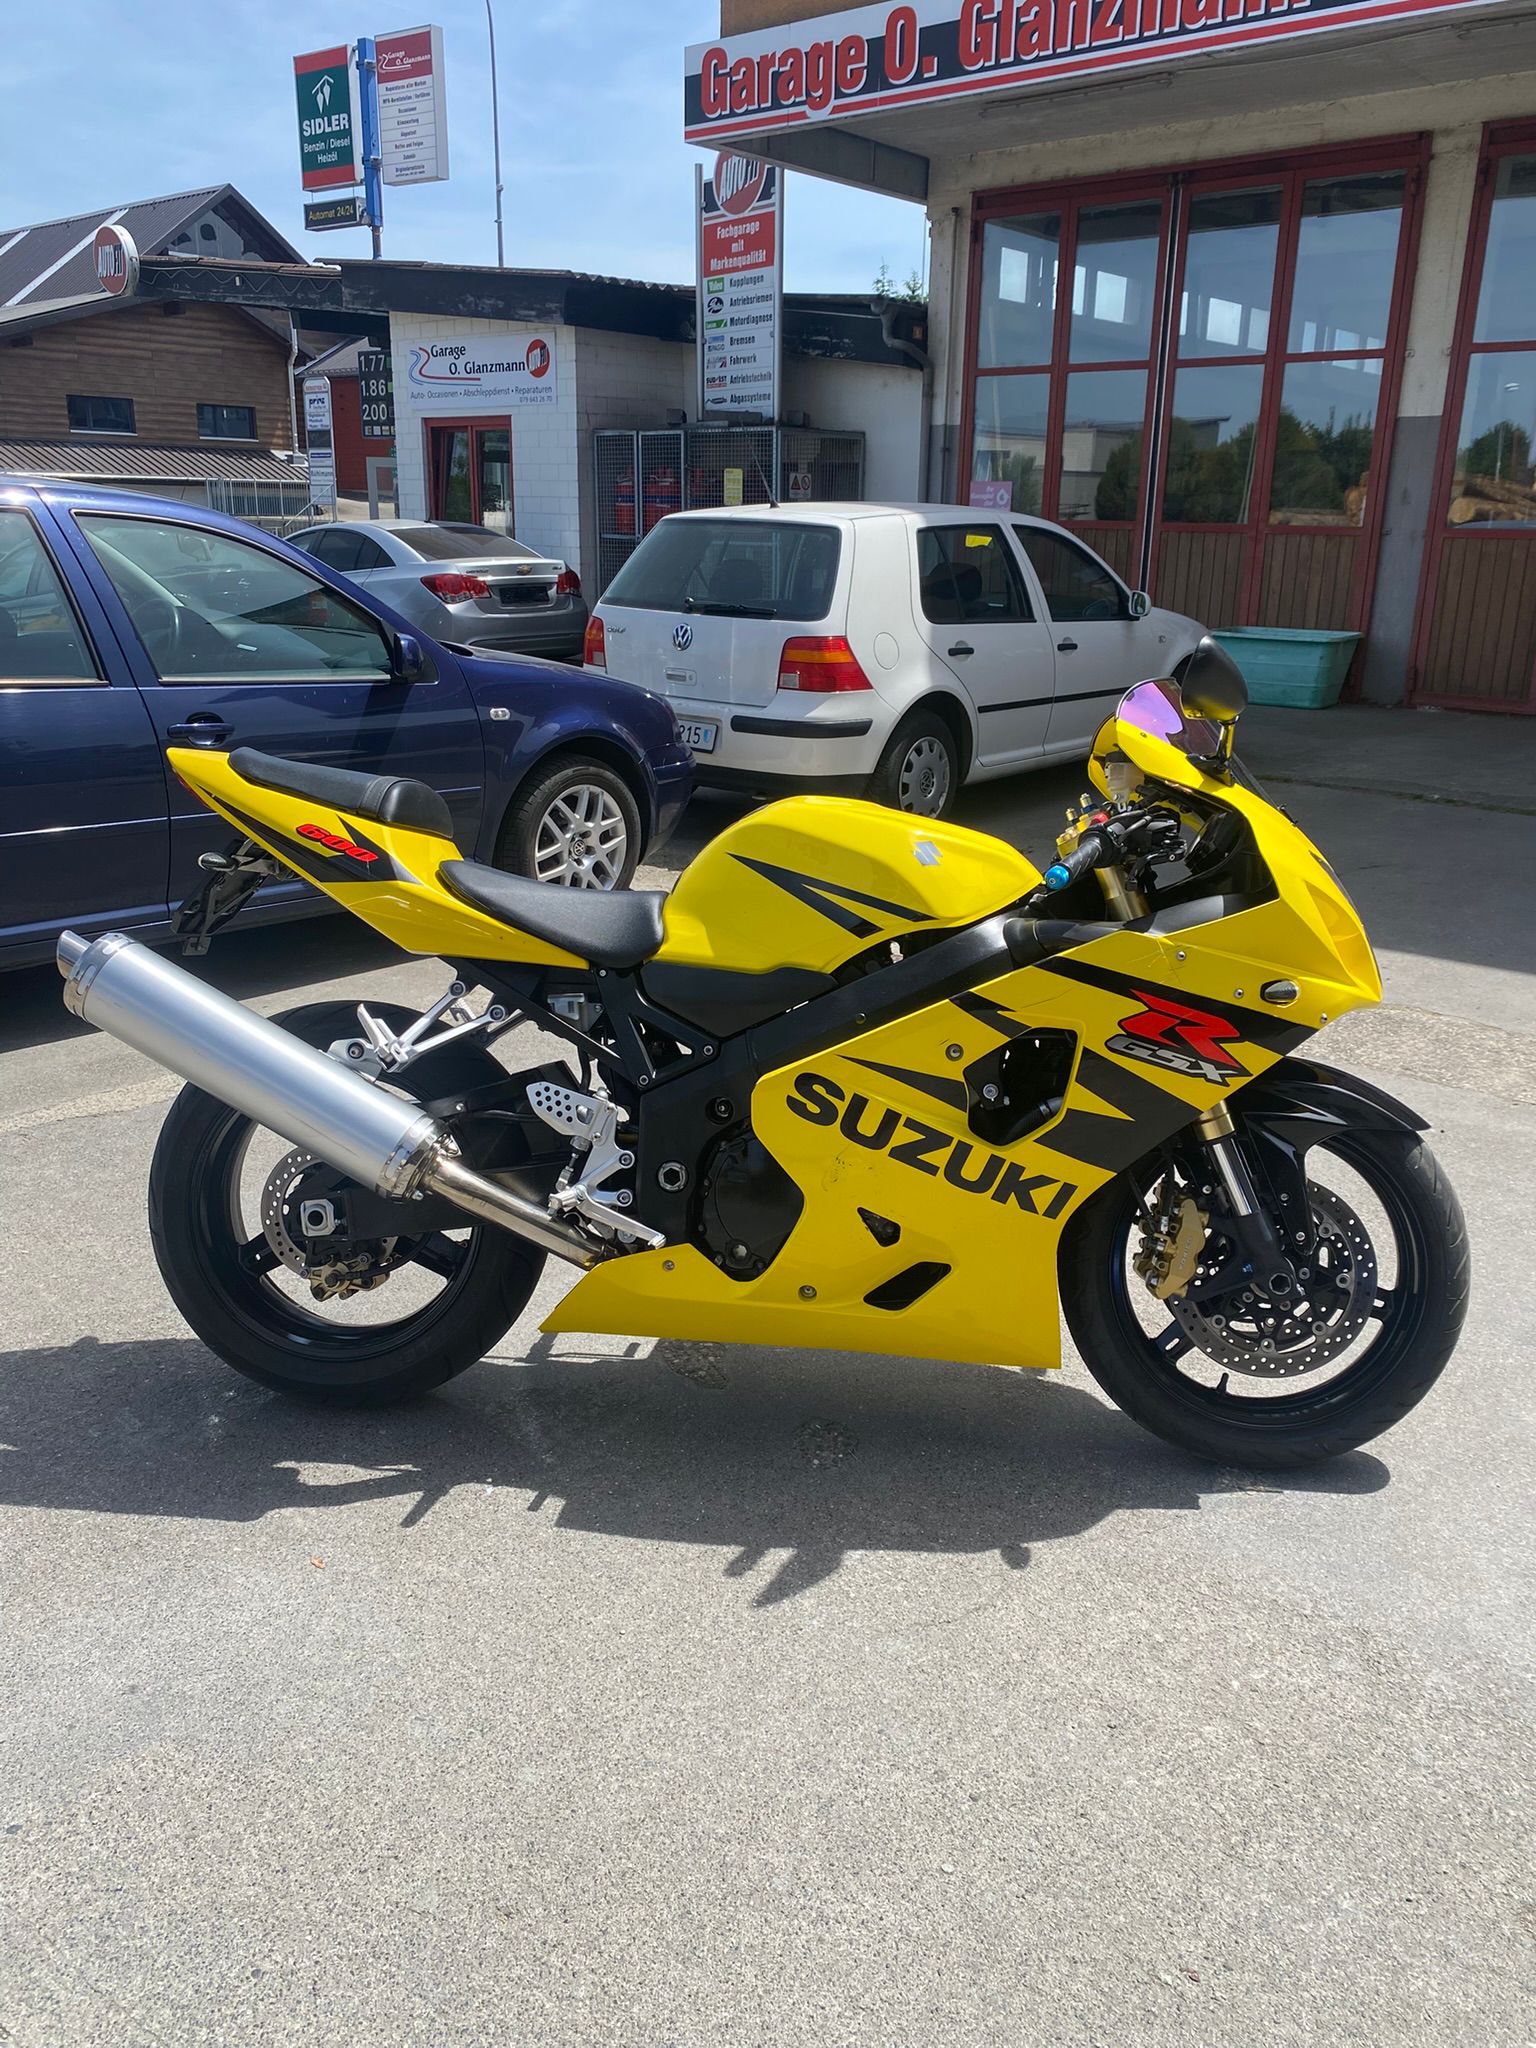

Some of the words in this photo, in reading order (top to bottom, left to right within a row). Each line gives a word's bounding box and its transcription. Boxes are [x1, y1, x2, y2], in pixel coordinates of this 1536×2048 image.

[387, 50, 405, 60] Garage
[402, 54, 431, 65] Glanzmann
[701, 35, 867, 118] Garage
[885, 5, 937, 84] O.
[302, 113, 349, 137] SIDLER
[303, 141, 326, 153] Benzin
[330, 136, 350, 149] Diesel
[317, 151, 338, 163] Heizöl
[309, 207, 335, 220] Automat
[336, 203, 354, 217] 24/24
[717, 221, 760, 239] Fachgarage
[731, 239, 744, 253] mit
[710, 249, 766, 271] Markenqualität
[730, 274, 764, 288] Kupplungen
[730, 293, 773, 307] Antriebsriemen
[730, 314, 773, 327] Motordiagnose
[730, 335, 756, 346] Bremsen
[430, 344, 466, 360] Garage
[730, 353, 757, 366] Fahrwerk
[360, 354, 385, 371] 1.77
[449, 362, 461, 376] O.
[464, 360, 526, 375] Glanzmann
[730, 371, 772, 385] Antriebstechnik
[361, 379, 386, 397] 1.86
[427, 390, 459, 399] Occasionen
[463, 387, 511, 399] Abschleppdienst
[515, 385, 553, 396] Reparaturen
[730, 392, 771, 405] Abgassysteme
[296, 824, 379, 862] 600
[1105, 1035, 1239, 1083] GSX
[786, 1072, 1079, 1220] SUZUKI
